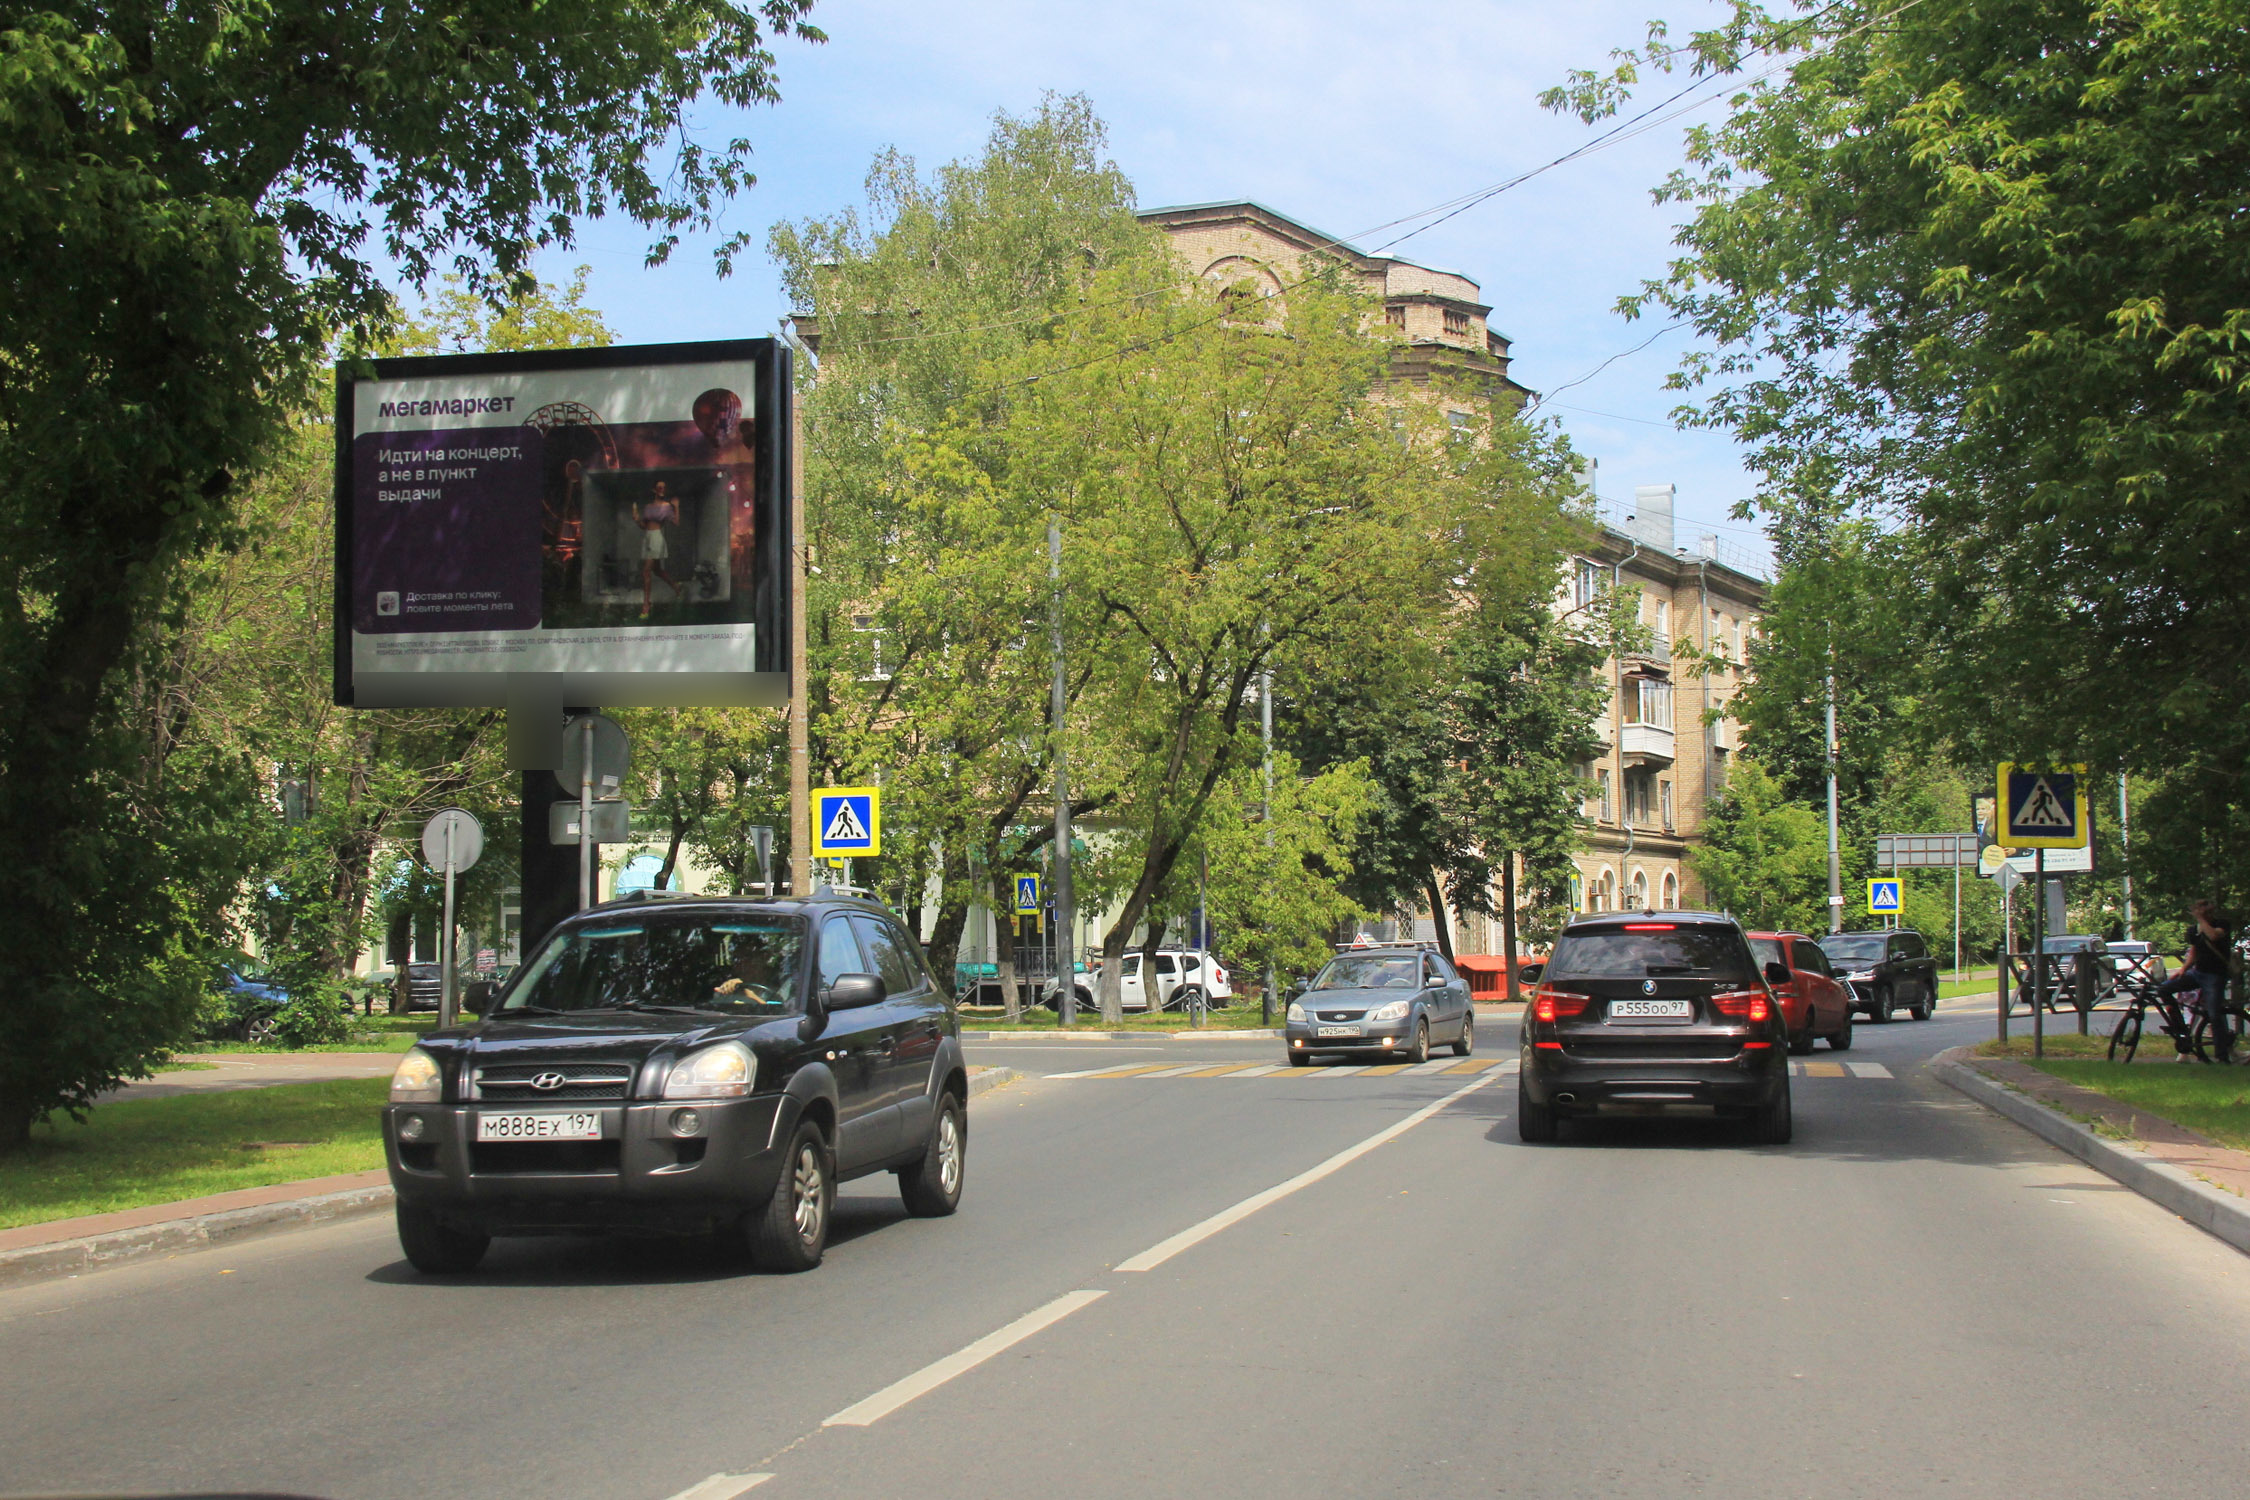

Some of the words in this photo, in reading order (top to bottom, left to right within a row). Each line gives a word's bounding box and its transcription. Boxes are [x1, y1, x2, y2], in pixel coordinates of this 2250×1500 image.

[379, 396, 515, 417] мегамаркет
[379, 449, 422, 465] Идти
[425, 449, 445, 461] на
[448, 446, 523, 461] концерт,
[378, 471, 388, 482] а
[391, 469, 412, 481] не
[416, 469, 425, 480] в
[428, 467, 477, 482] пункт
[378, 488, 442, 503] выдачи
[406, 592, 453, 603] Доставка
[455, 592, 467, 600] по
[406, 605, 441, 613] ловите
[443, 603, 489, 612] моменты
[490, 602, 514, 610] лета
[1671, 1001, 1684, 1011] 97
[485, 1116, 561, 1136] М888ЕХ
[567, 1114, 595, 1130] 197
